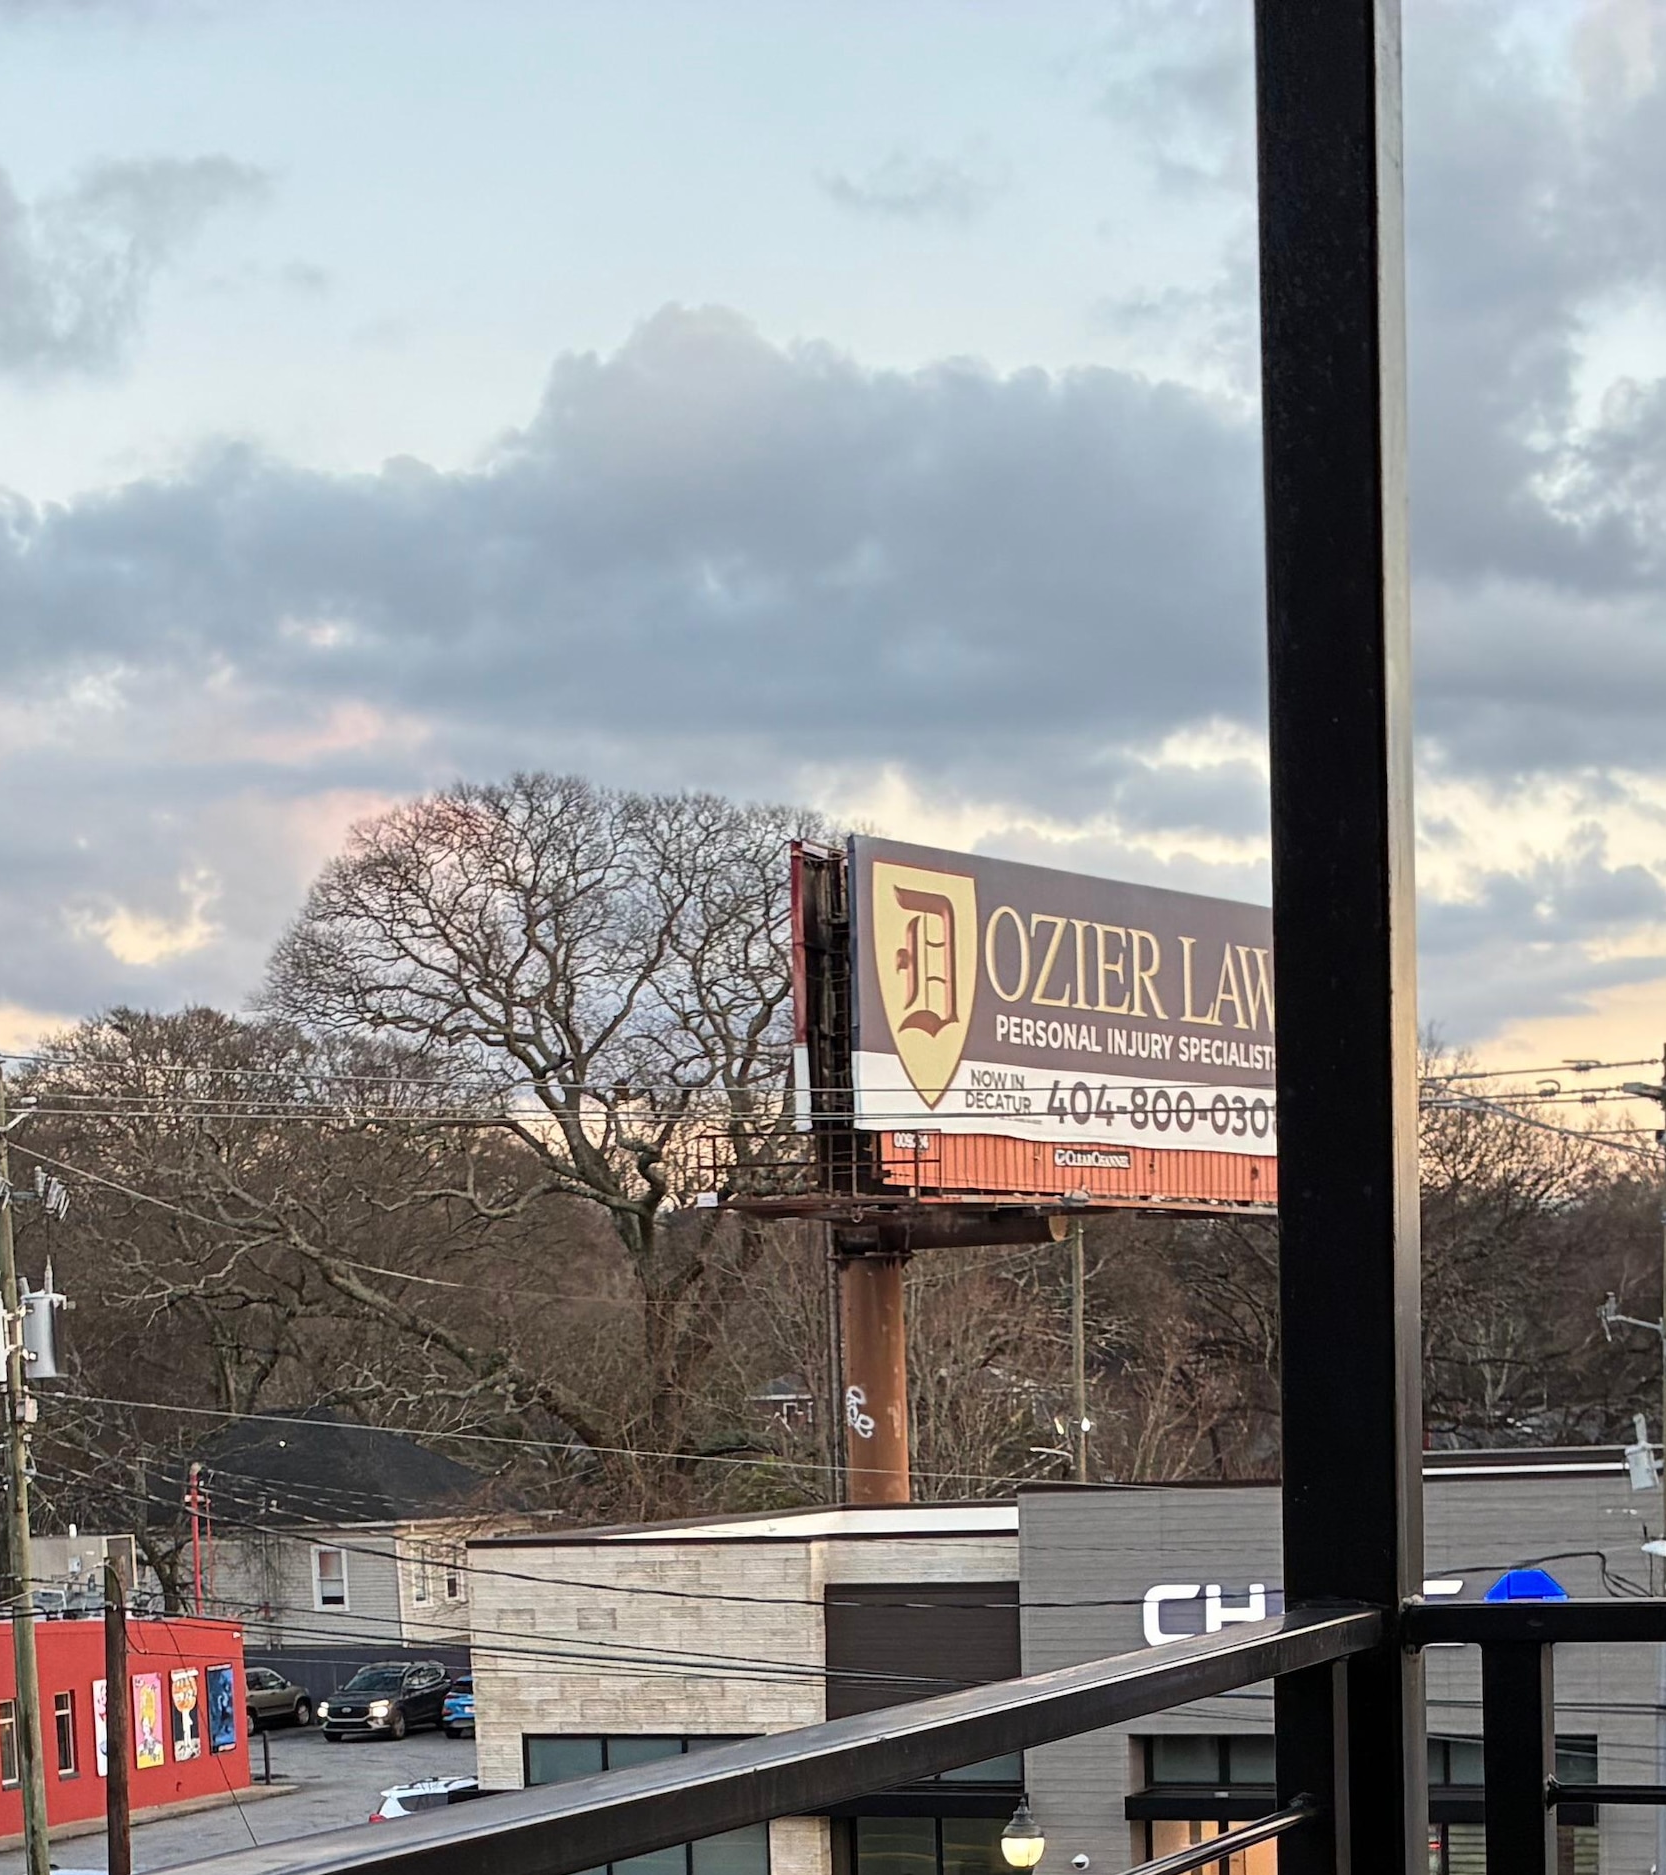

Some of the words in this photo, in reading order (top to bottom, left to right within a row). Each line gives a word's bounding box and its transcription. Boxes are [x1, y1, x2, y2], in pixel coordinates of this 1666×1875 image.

[1178, 936, 1275, 1032] LAW
[995, 1013, 1102, 1053] PERSONAL
[1107, 1027, 1174, 1061] INJURY
[965, 1090, 1032, 1114] DECATUR
[970, 1068, 1007, 1090] NOW
[1010, 1073, 1025, 1091] IN
[1047, 1079, 1276, 1139] 404-800-030
